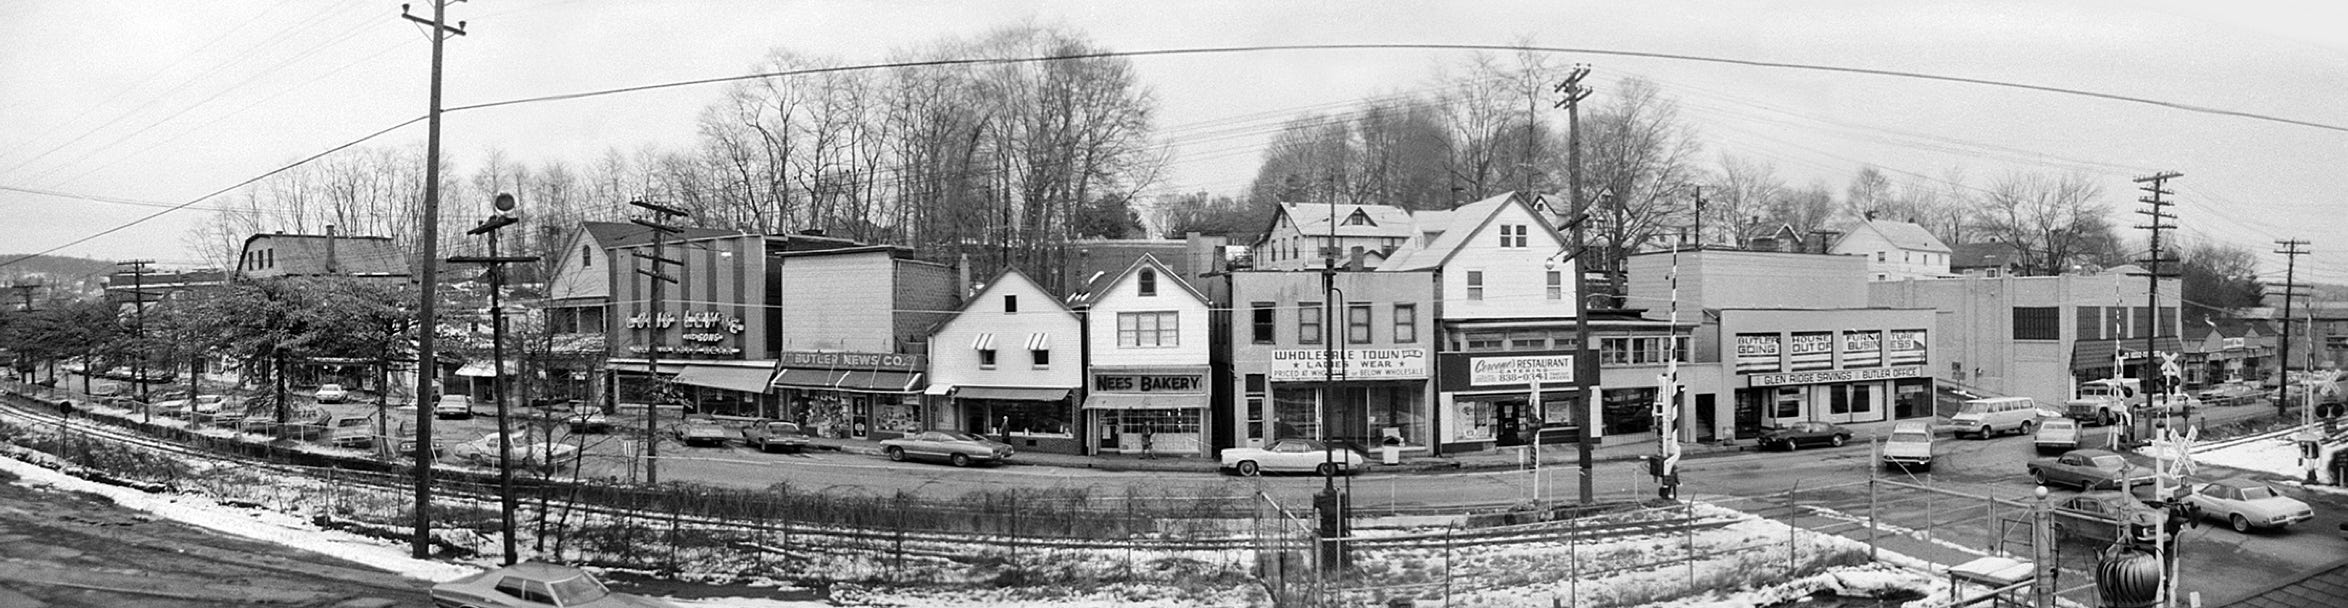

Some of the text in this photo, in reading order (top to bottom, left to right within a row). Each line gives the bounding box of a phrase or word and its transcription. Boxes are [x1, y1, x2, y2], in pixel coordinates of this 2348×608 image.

[1738, 335, 1780, 345] BUTLER
[1792, 334, 1830, 343] HOUSE
[1737, 344, 1777, 354] GOING
[1792, 342, 1814, 353] OUT
[1818, 341, 1832, 351] OF
[794, 353, 906, 367] BUTLER NEWS CO.
[1362, 350, 1400, 360] TOWN
[1361, 360, 1392, 368] WEAR
[1517, 358, 1569, 369] RESTAURANT
[1274, 369, 1299, 377] PRICED
[1301, 369, 1309, 377] AT
[1311, 369, 1349, 377] WHOSAE
[1360, 369, 1381, 377] BELOW
[1385, 368, 1424, 376] WHOLESALE
[1764, 368, 1917, 385] GLEN RIDGE SAVINGS BUTLER OFFICE
[1096, 375, 1200, 392] NEES BAKERY
